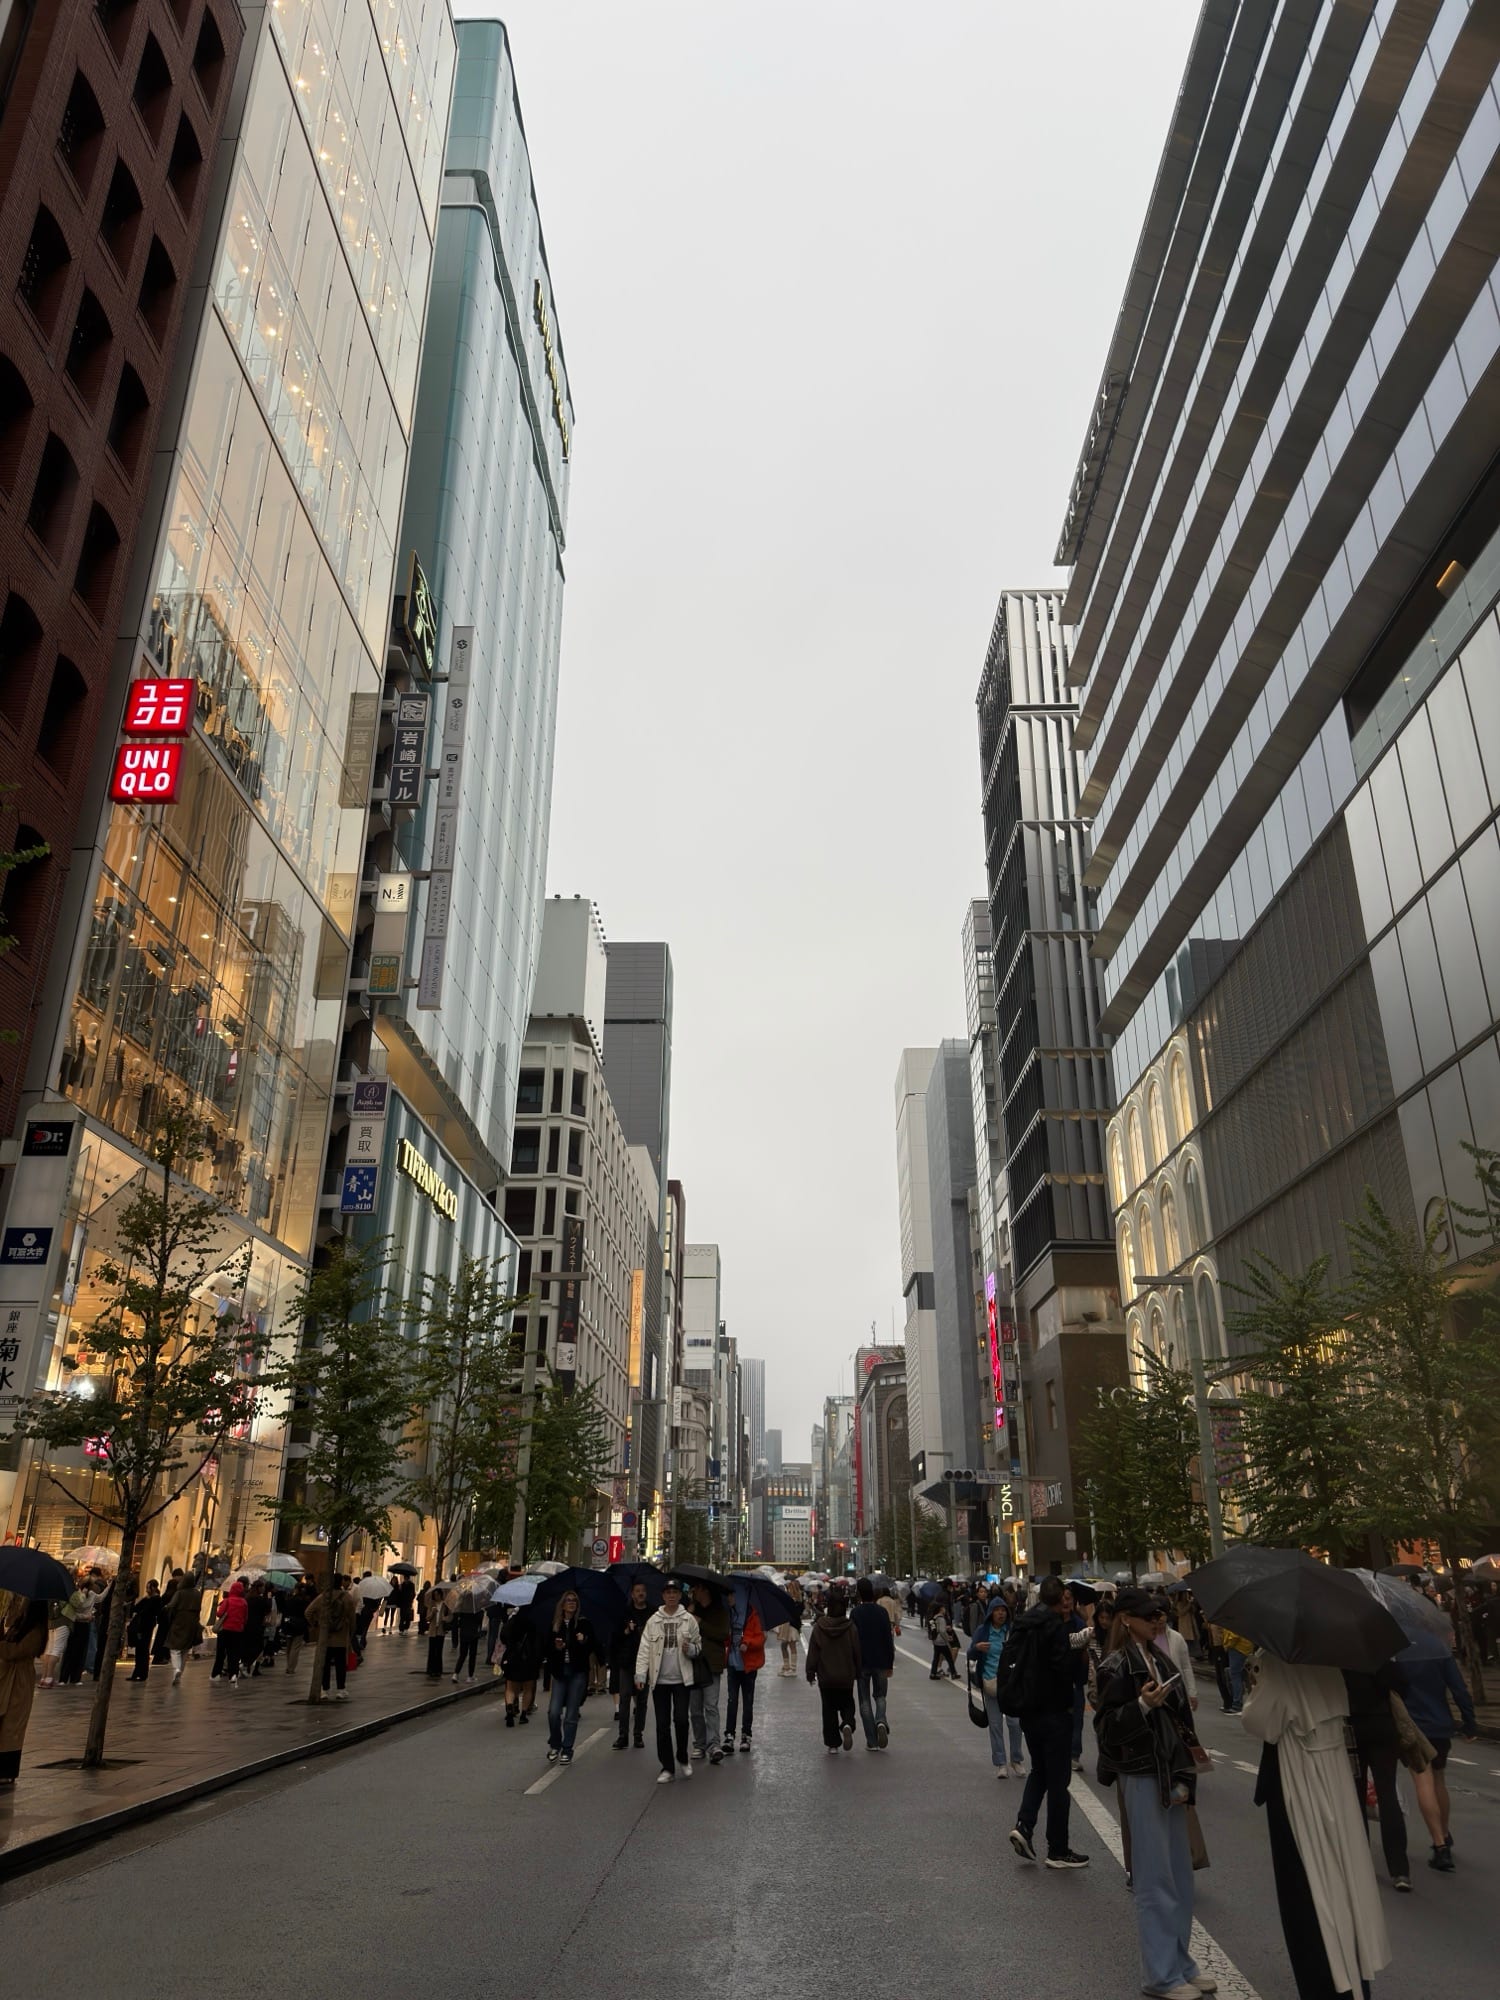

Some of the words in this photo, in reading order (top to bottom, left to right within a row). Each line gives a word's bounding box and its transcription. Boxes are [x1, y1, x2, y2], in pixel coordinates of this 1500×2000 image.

[139, 685, 185, 702] ユニ
[133, 706, 182, 724] クロ
[124, 750, 170, 769] UNI
[395, 731, 419, 800] 岩崎ビル
[120, 772, 171, 795] QLO
[358, 1126, 373, 1153] 買取
[346, 1175, 372, 1201] 青山
[6, 1310, 21, 1333] 銀座
[1001, 1484, 1013, 1520] ANCL
